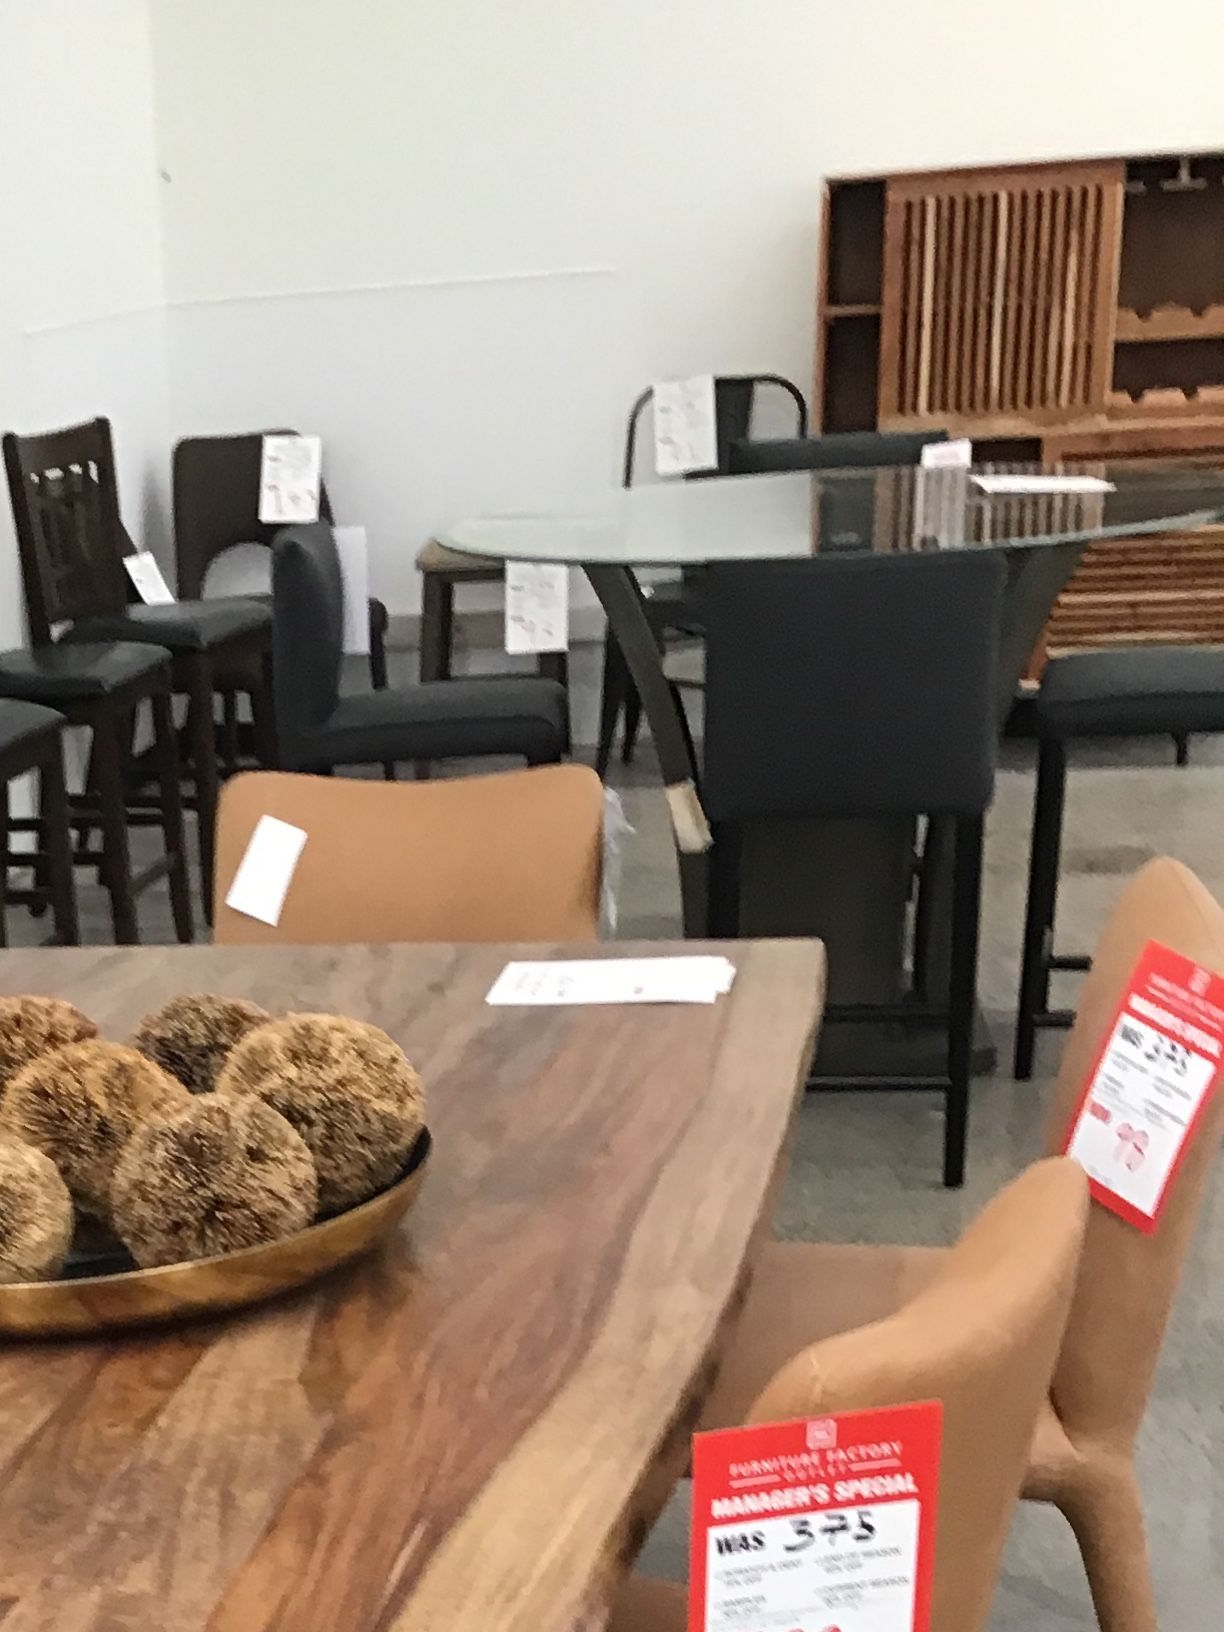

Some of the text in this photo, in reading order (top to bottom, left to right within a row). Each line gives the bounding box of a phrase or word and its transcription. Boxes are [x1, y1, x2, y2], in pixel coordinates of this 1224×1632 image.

[711, 1472, 919, 1519] MANAGER'S SPECIAL
[716, 1528, 766, 1557] WAS
